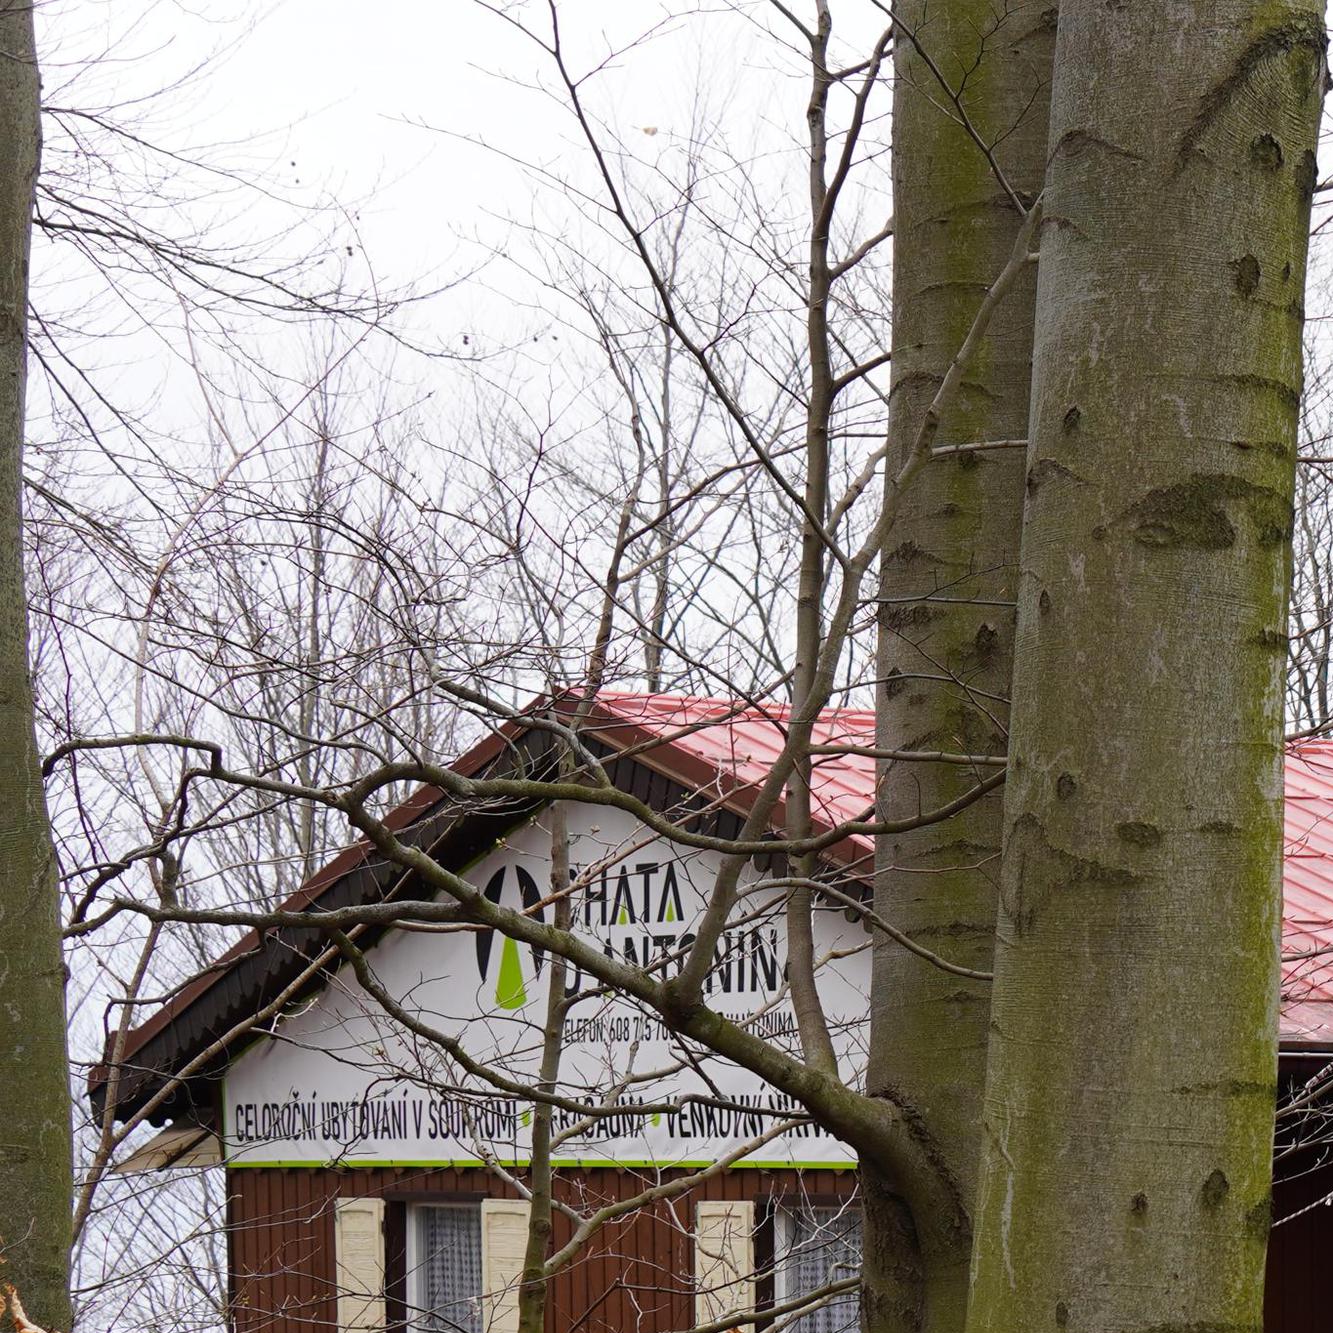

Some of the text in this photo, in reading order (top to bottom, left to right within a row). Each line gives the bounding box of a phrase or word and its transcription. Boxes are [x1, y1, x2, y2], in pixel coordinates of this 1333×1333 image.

[569, 862, 685, 926] HATA
[564, 1015, 606, 1043] ELEFON:
[609, 1016, 630, 1042] 608
[633, 1017, 651, 1041] 75
[235, 1090, 317, 1141] CELOROČNÍ
[321, 1089, 408, 1141] UBYTOVÁNÍ
[412, 1099, 421, 1140] V
[550, 1096, 646, 1139] FRASAUNA
[666, 1081, 766, 1139] VENKOVNÍ
